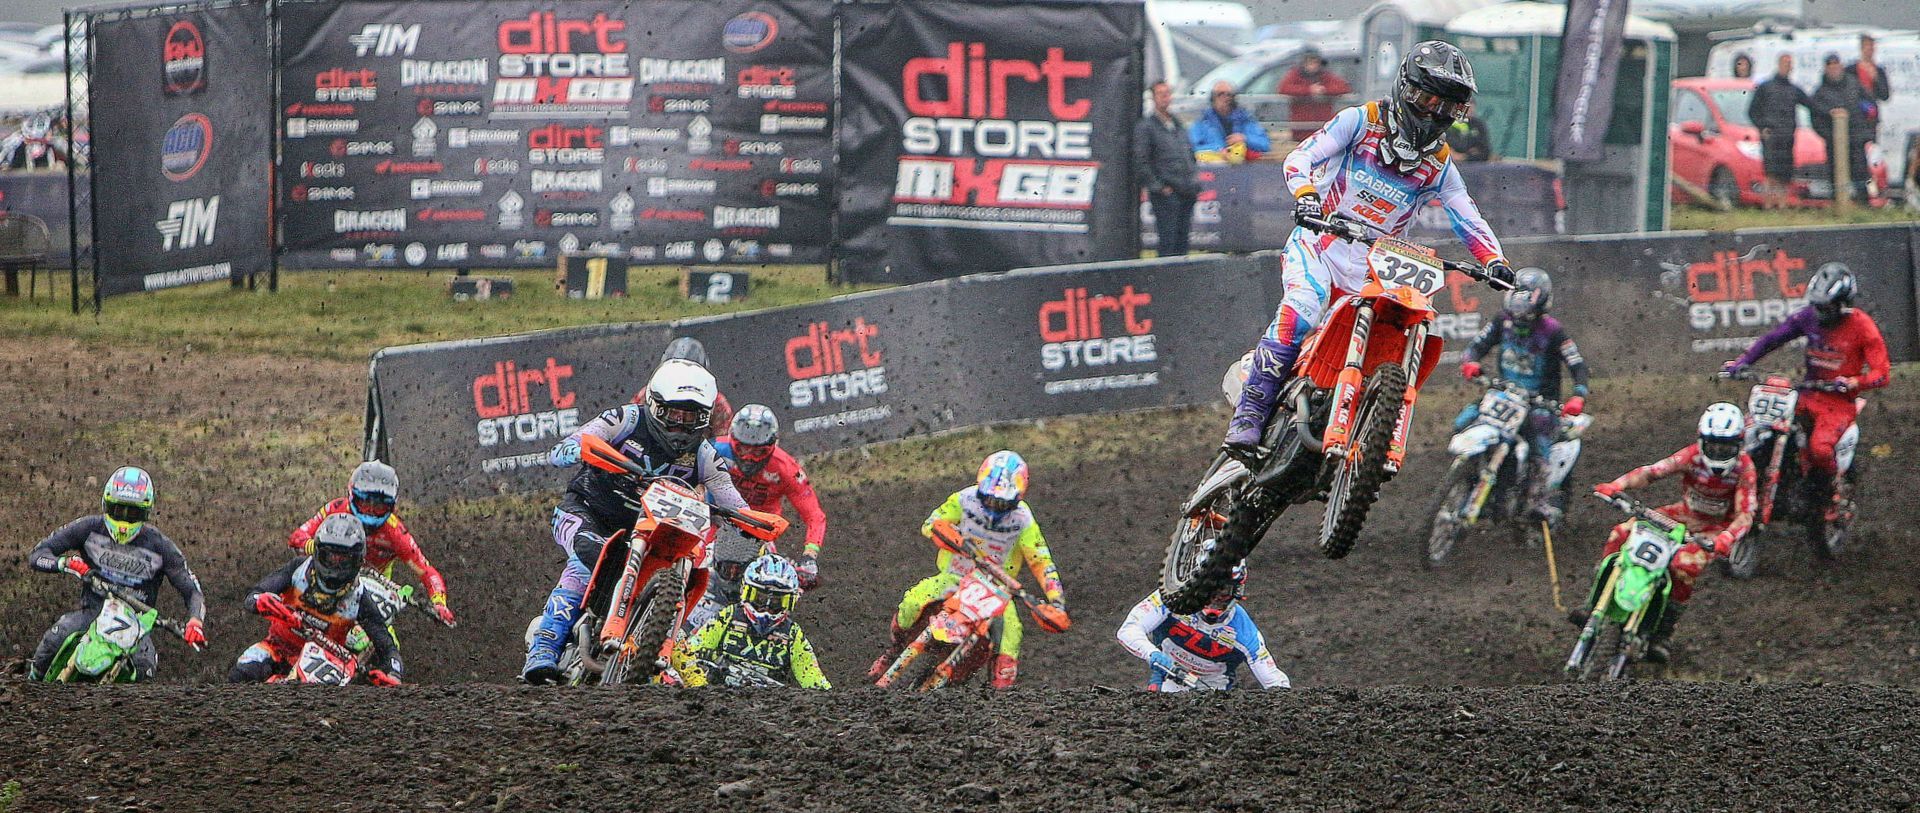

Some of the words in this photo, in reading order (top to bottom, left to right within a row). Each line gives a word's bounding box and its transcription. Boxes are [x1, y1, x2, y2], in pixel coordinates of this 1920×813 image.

[349, 23, 421, 56] FIM
[499, 11, 628, 52] dirt
[315, 67, 378, 88] dirt
[401, 58, 489, 86] DRAGON
[499, 53, 630, 77] STORE
[902, 41, 1093, 121] dirt
[314, 86, 378, 102] STORE
[528, 124, 603, 149] dirt
[902, 116, 1093, 159] STORE
[528, 148, 604, 164] STORE
[893, 157, 1100, 208] MXGB
[155, 194, 221, 252] FIM
[1352, 203, 1387, 224] KTM
[586, 258, 608, 300] 1
[707, 273, 734, 302] 2
[1377, 255, 1437, 294] 326
[1687, 250, 1808, 302] dirt
[1038, 284, 1154, 343] dirt
[785, 316, 881, 379] dirt
[1041, 334, 1158, 370] STORE
[473, 357, 576, 419] dirt
[789, 366, 889, 407] STORE
[477, 408, 580, 447] STORE
[1634, 541, 1663, 565] 6
[960, 583, 1003, 618] 84
[104, 616, 131, 635] 7
